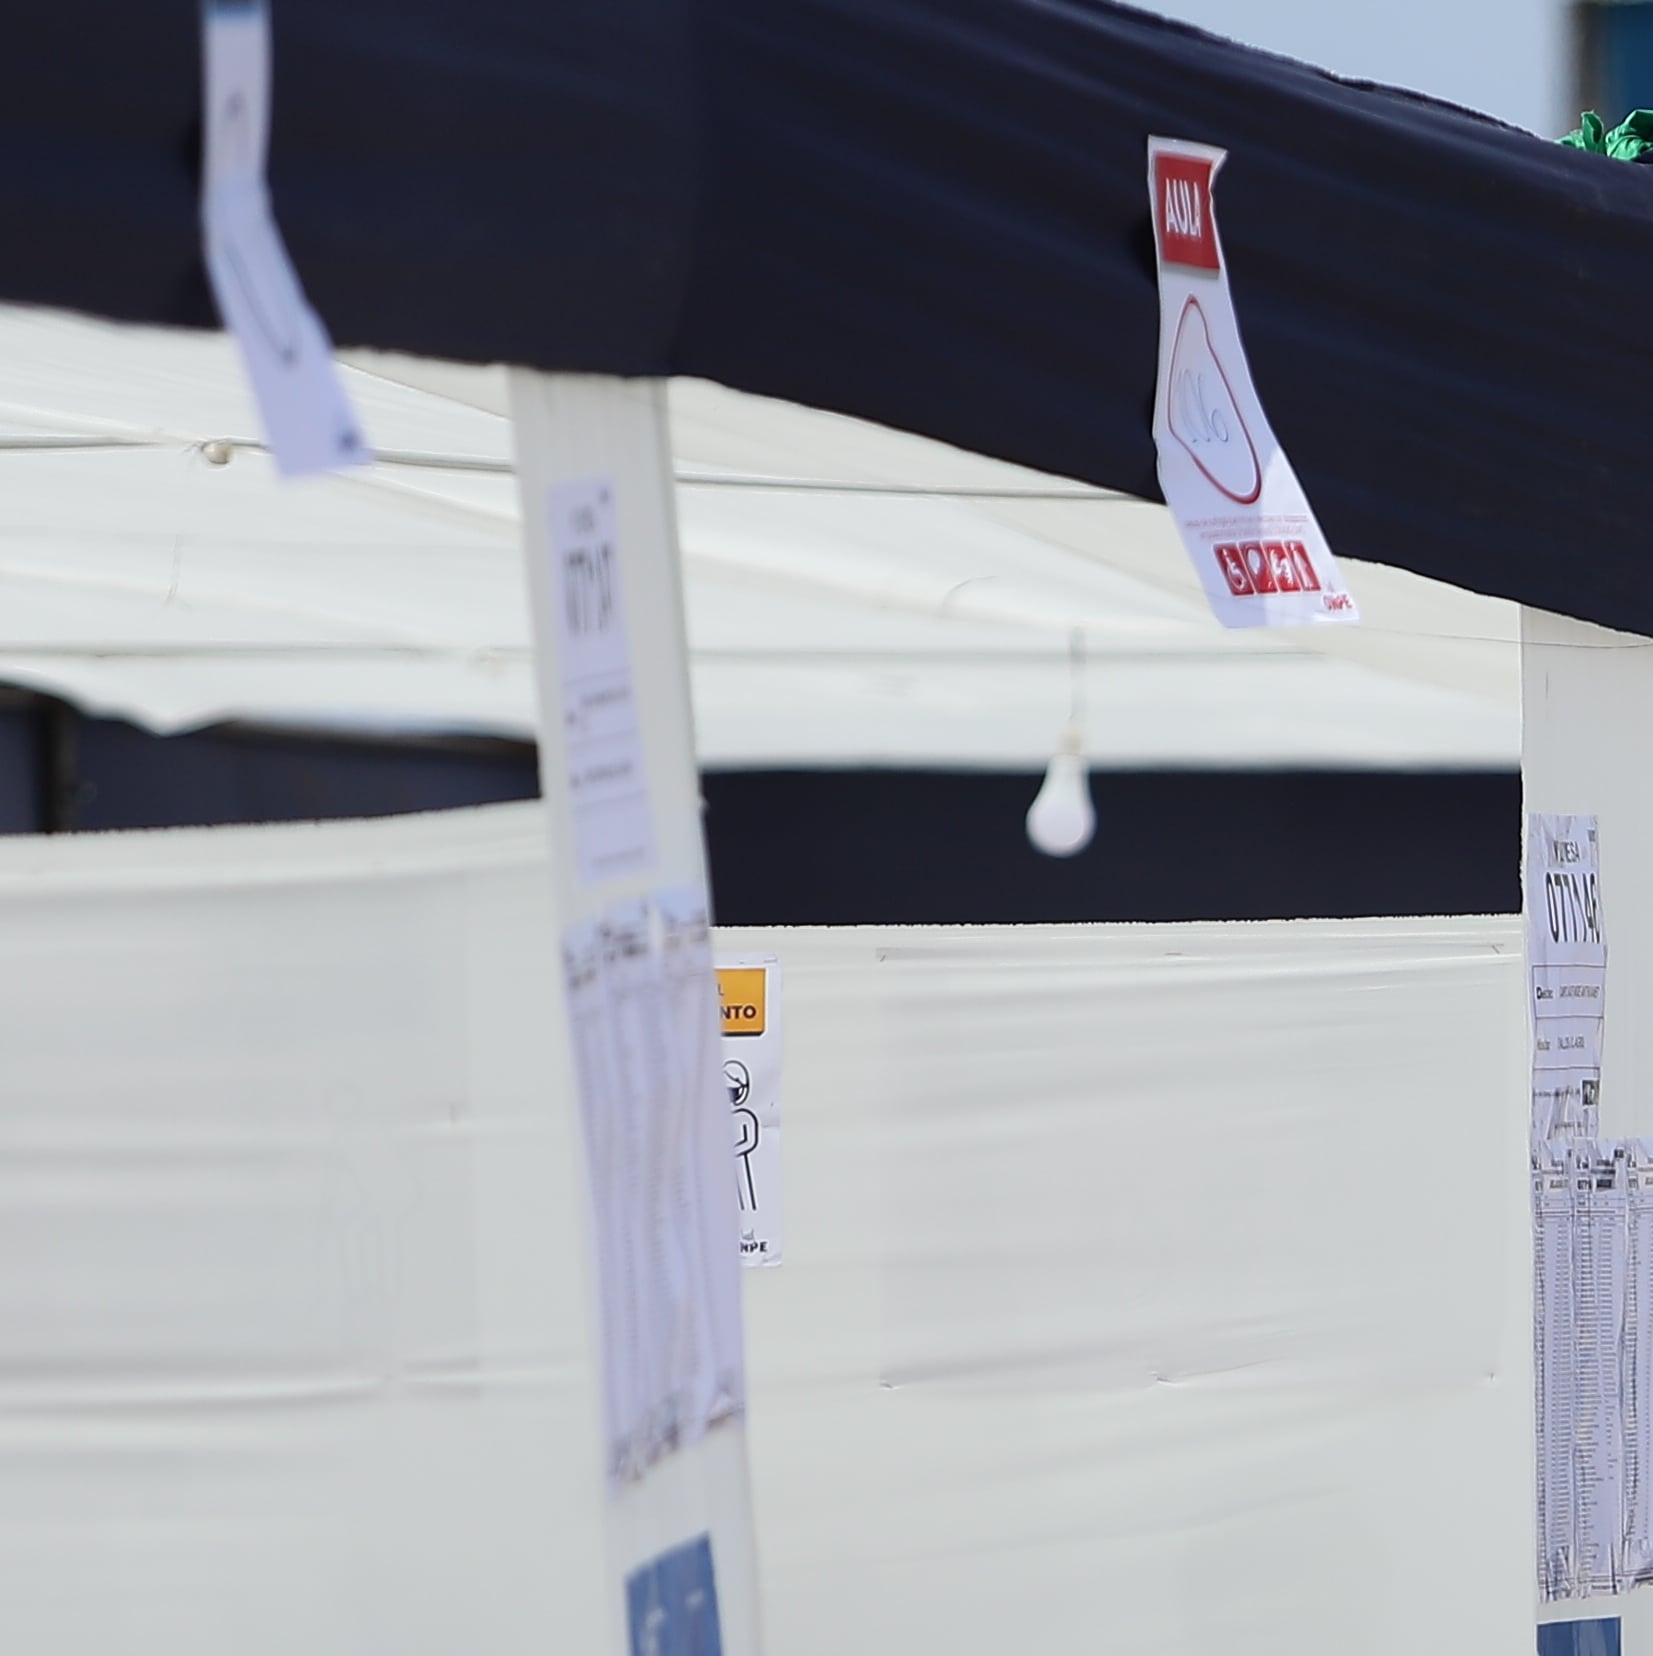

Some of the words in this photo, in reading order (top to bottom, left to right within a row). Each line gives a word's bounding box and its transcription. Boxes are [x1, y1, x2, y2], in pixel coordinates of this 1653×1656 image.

[1165, 177, 1201, 238] AULA
[720, 1004, 757, 1020] NTO
[740, 1241, 768, 1252] NPE
